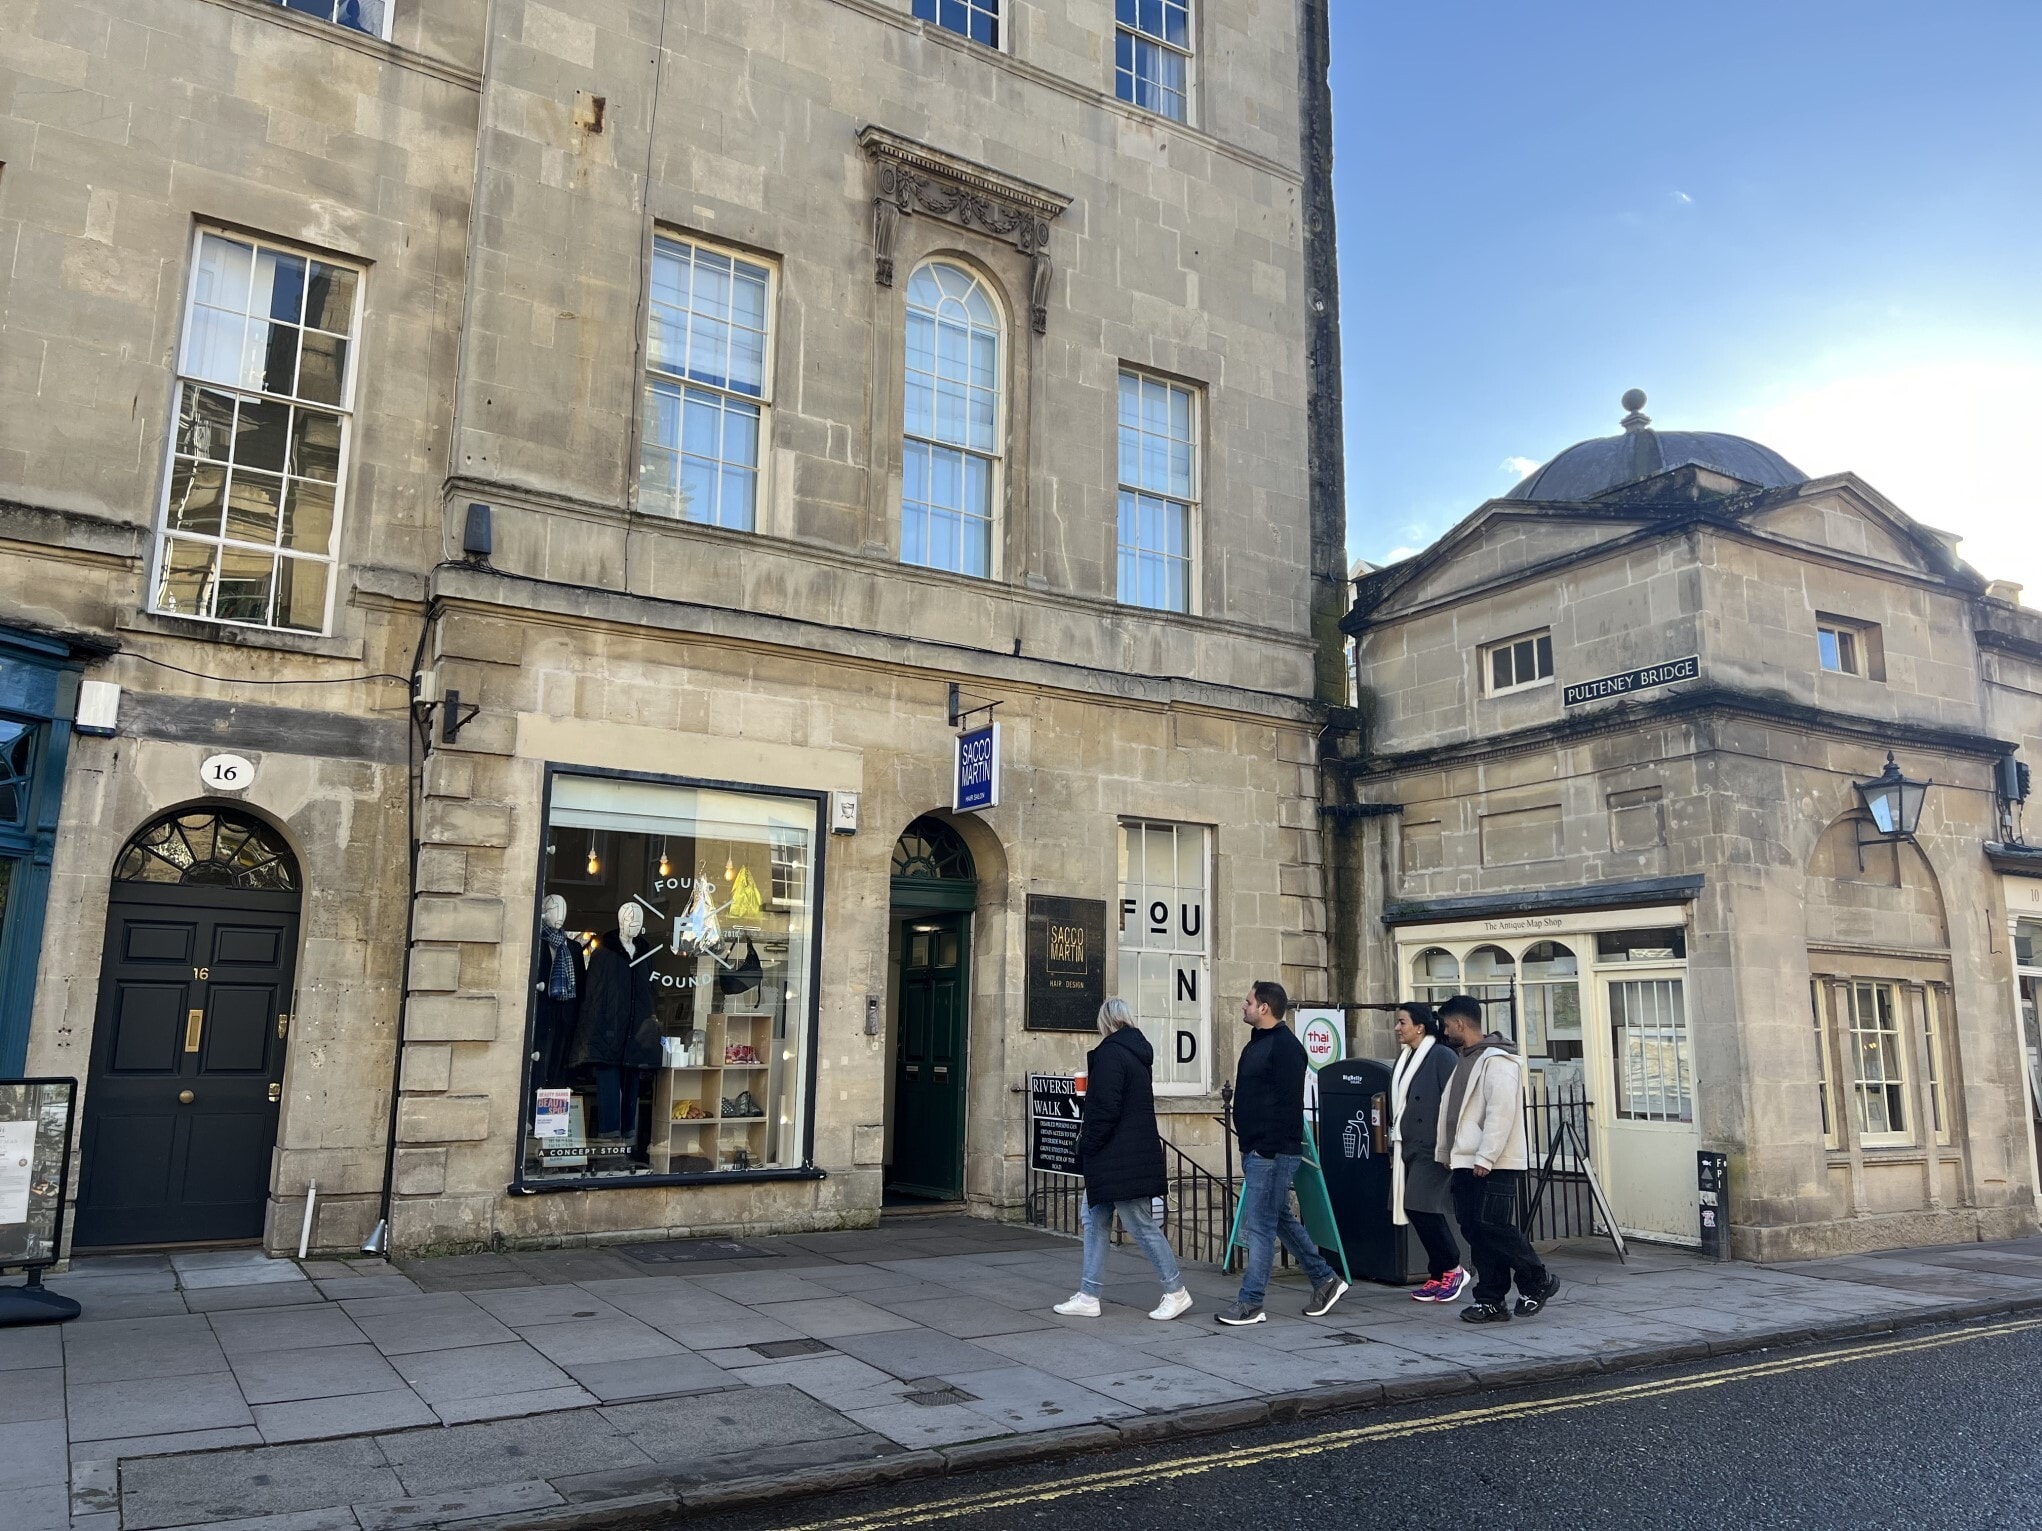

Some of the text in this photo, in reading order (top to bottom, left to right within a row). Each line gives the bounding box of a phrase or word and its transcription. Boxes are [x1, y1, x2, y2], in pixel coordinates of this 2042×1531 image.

[1568, 661, 1694, 702] PULTENEY BRIDGE
[962, 738, 991, 766] SACCO
[213, 764, 238, 781] 16
[962, 760, 991, 787] MARTIN
[654, 878, 716, 893] FOUND
[1484, 917, 1562, 930] The Antique Map Shop
[1051, 925, 1084, 946] SACCO
[1051, 943, 1084, 963] MARTIN
[193, 967, 210, 980] 16
[649, 971, 711, 988] FOUND
[1065, 980, 1084, 989] DESIGN
[1308, 1031, 1329, 1042] thai
[1310, 1043, 1331, 1053] weir
[1033, 1079, 1077, 1095] RIVERSID
[538, 1099, 568, 1108] BEAUTY
[548, 1107, 567, 1115] SPOT
[1034, 1100, 1061, 1116] WALK
[550, 1148, 597, 1156] CONCEPT
[600, 1147, 632, 1155] STORE
